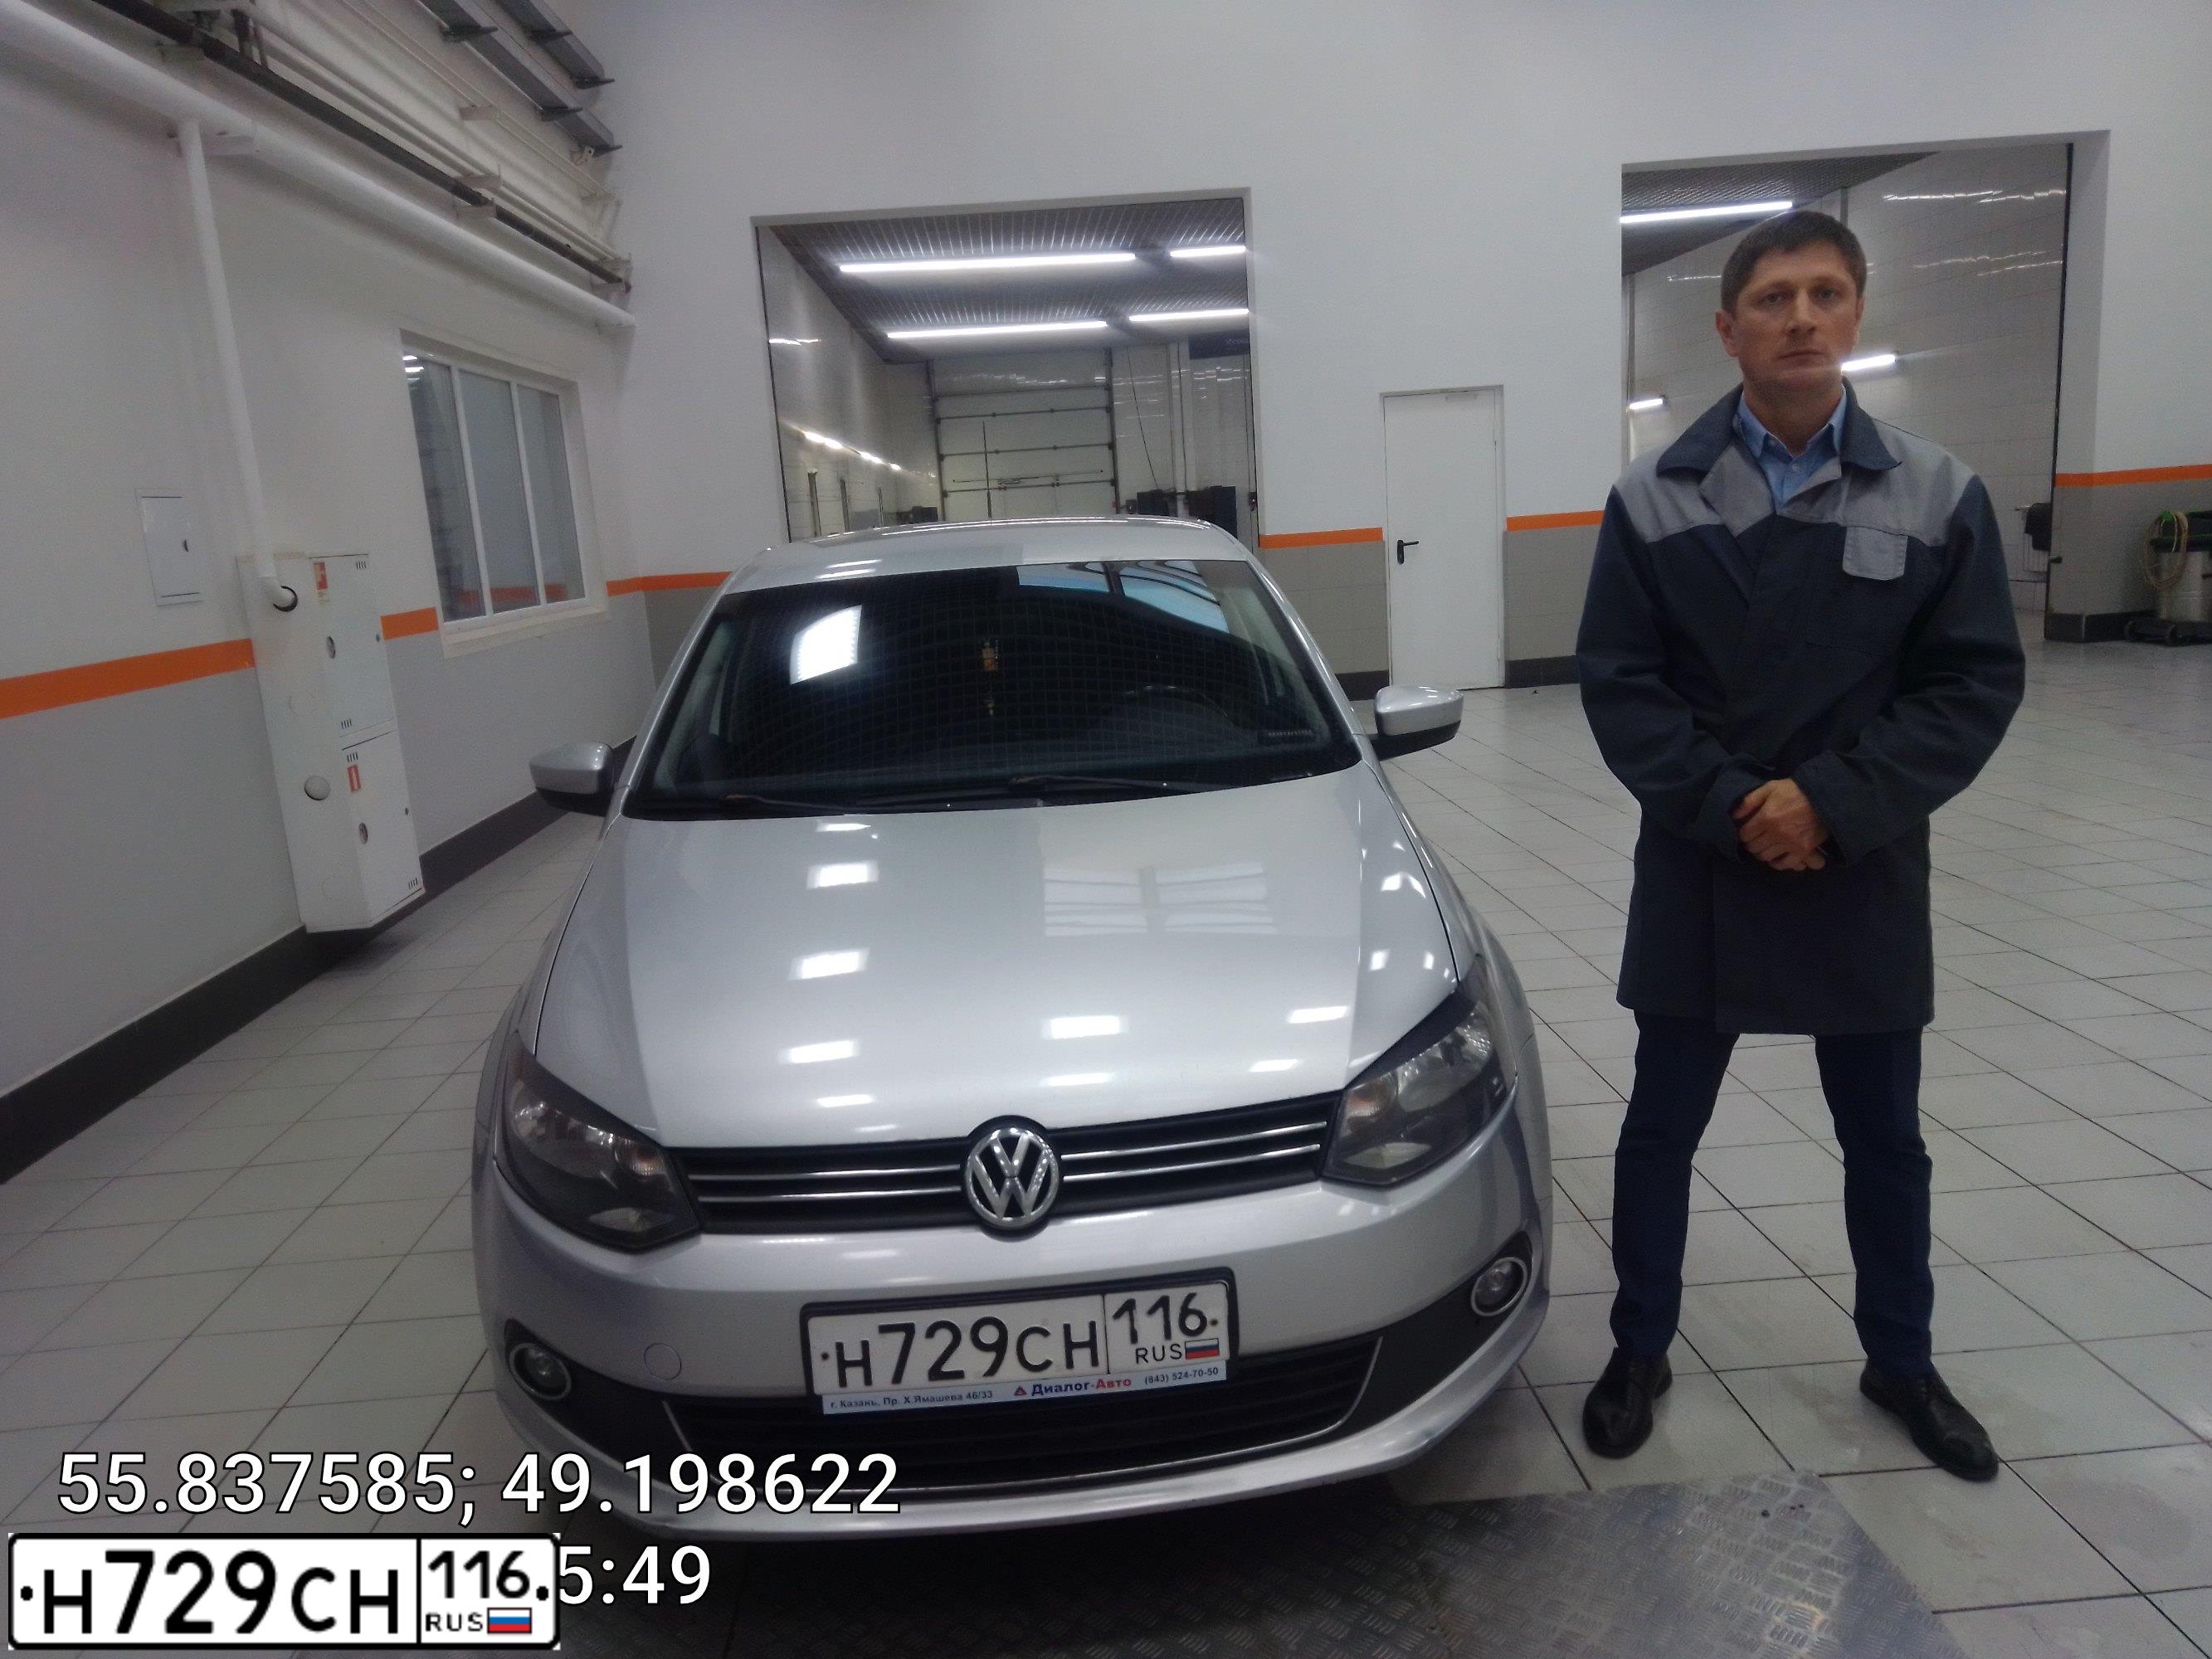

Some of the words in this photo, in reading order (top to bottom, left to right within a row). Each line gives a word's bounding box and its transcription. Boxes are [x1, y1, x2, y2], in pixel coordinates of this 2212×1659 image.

[1112, 1292, 1208, 1345] 116
[1135, 1343, 1183, 1365] RUS
[1144, 1374, 1169, 1386] (843)
[1172, 1366, 1220, 1381] 524-70-50
[965, 1389, 993, 1400] 46/33
[1030, 1378, 1132, 1397] Диалог-Авто
